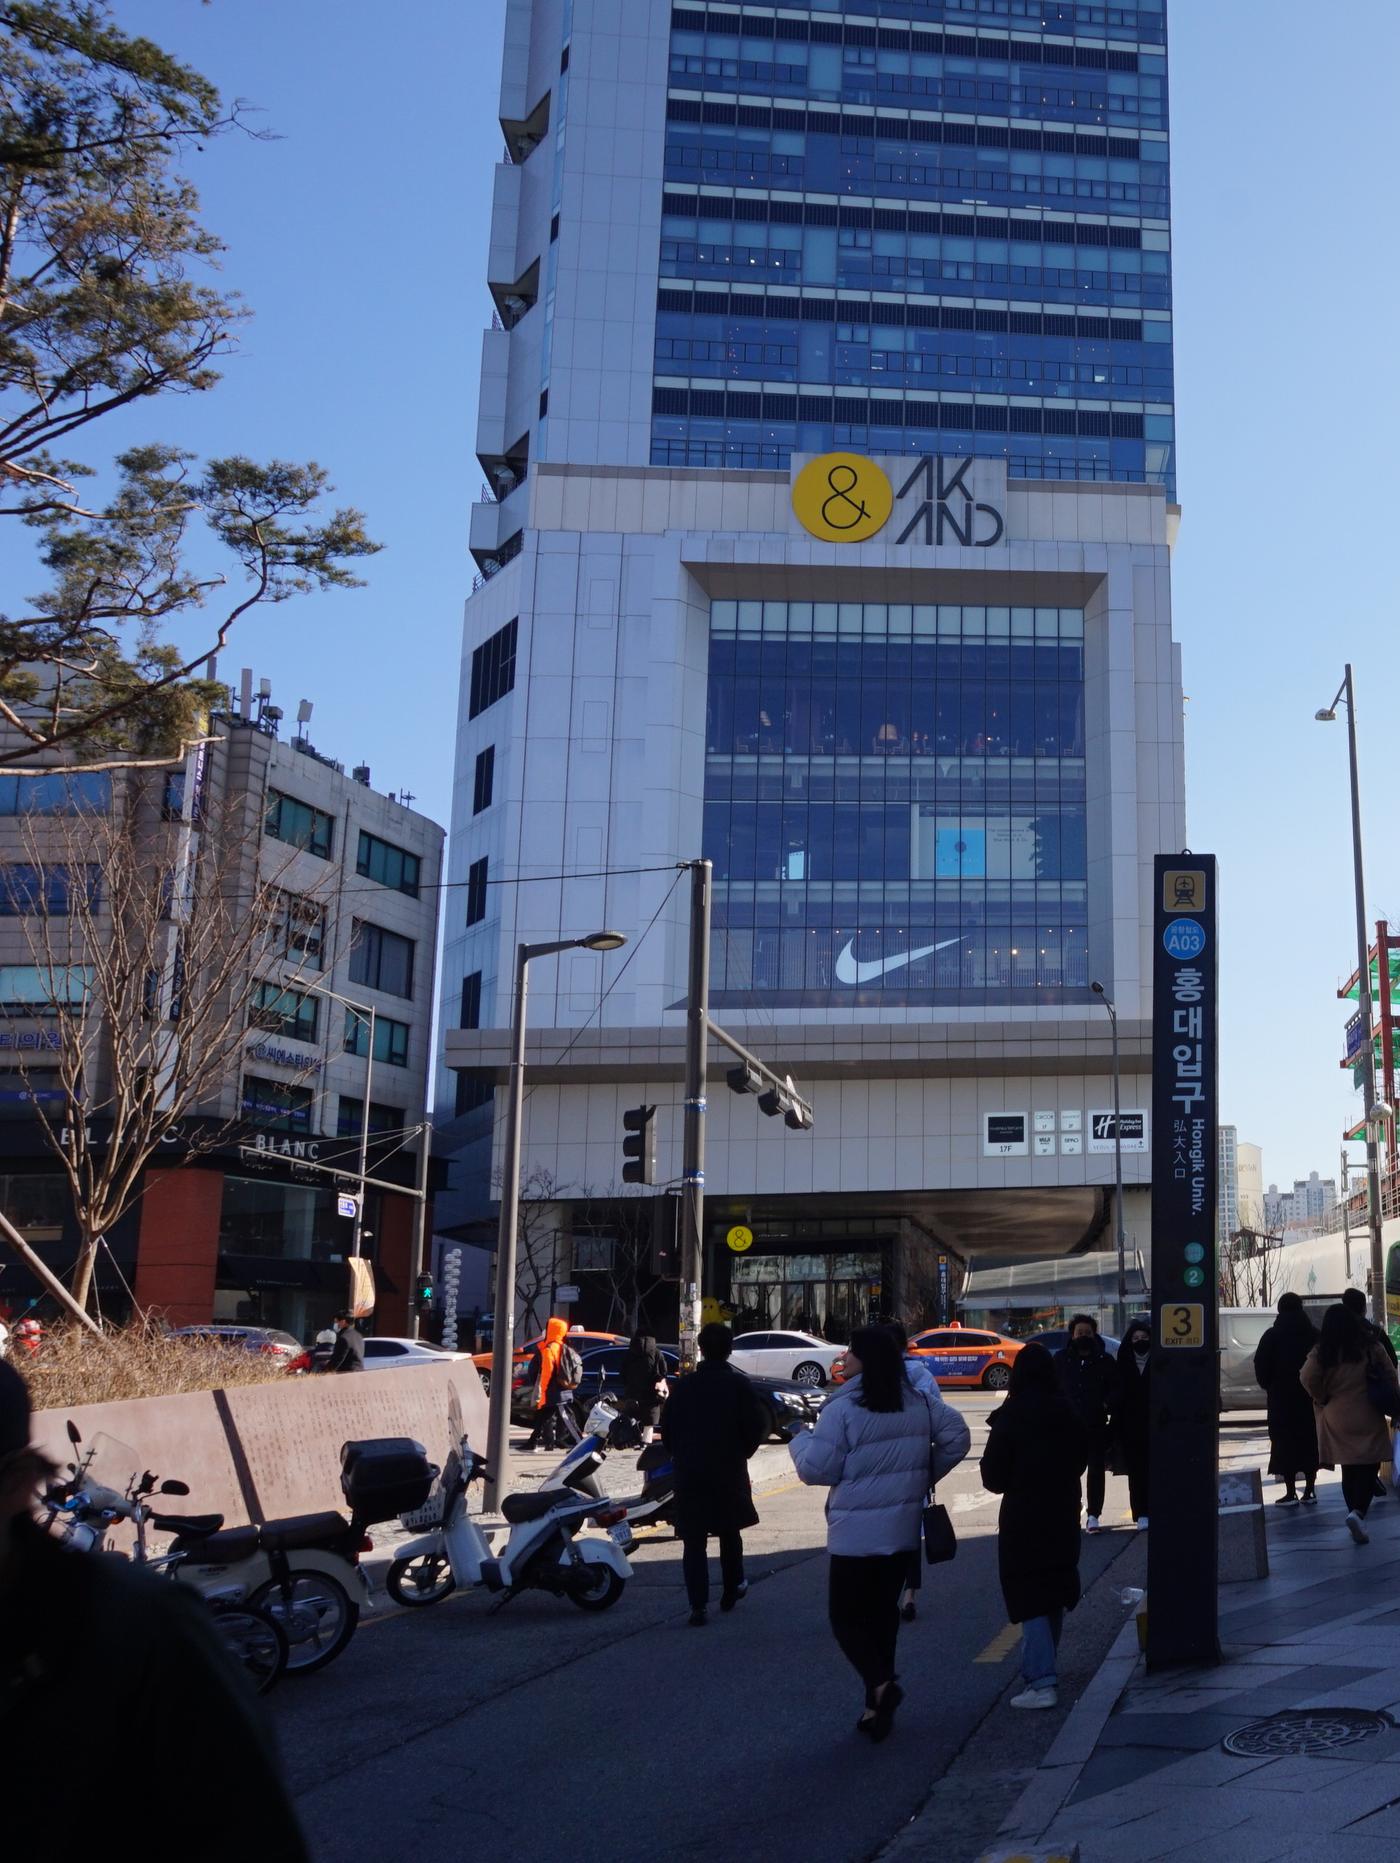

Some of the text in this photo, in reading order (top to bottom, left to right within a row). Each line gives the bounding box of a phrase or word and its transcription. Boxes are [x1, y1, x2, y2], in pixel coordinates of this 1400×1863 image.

[896, 455, 974, 501] AK
[896, 501, 1003, 547] AND
[1168, 935, 1200, 951] A03
[1172, 968, 1206, 1114] 홍대입구
[60, 1126, 178, 1145] BLAC
[256, 1133, 320, 1161] BLANC
[1173, 1119, 1188, 1179] 弘大入口
[1189, 1118, 1205, 1216] Hongik Univ.
[1189, 1270, 1199, 1283] 2
[1172, 1306, 1192, 1337] 3
[1165, 1337, 1182, 1345] EXIT
